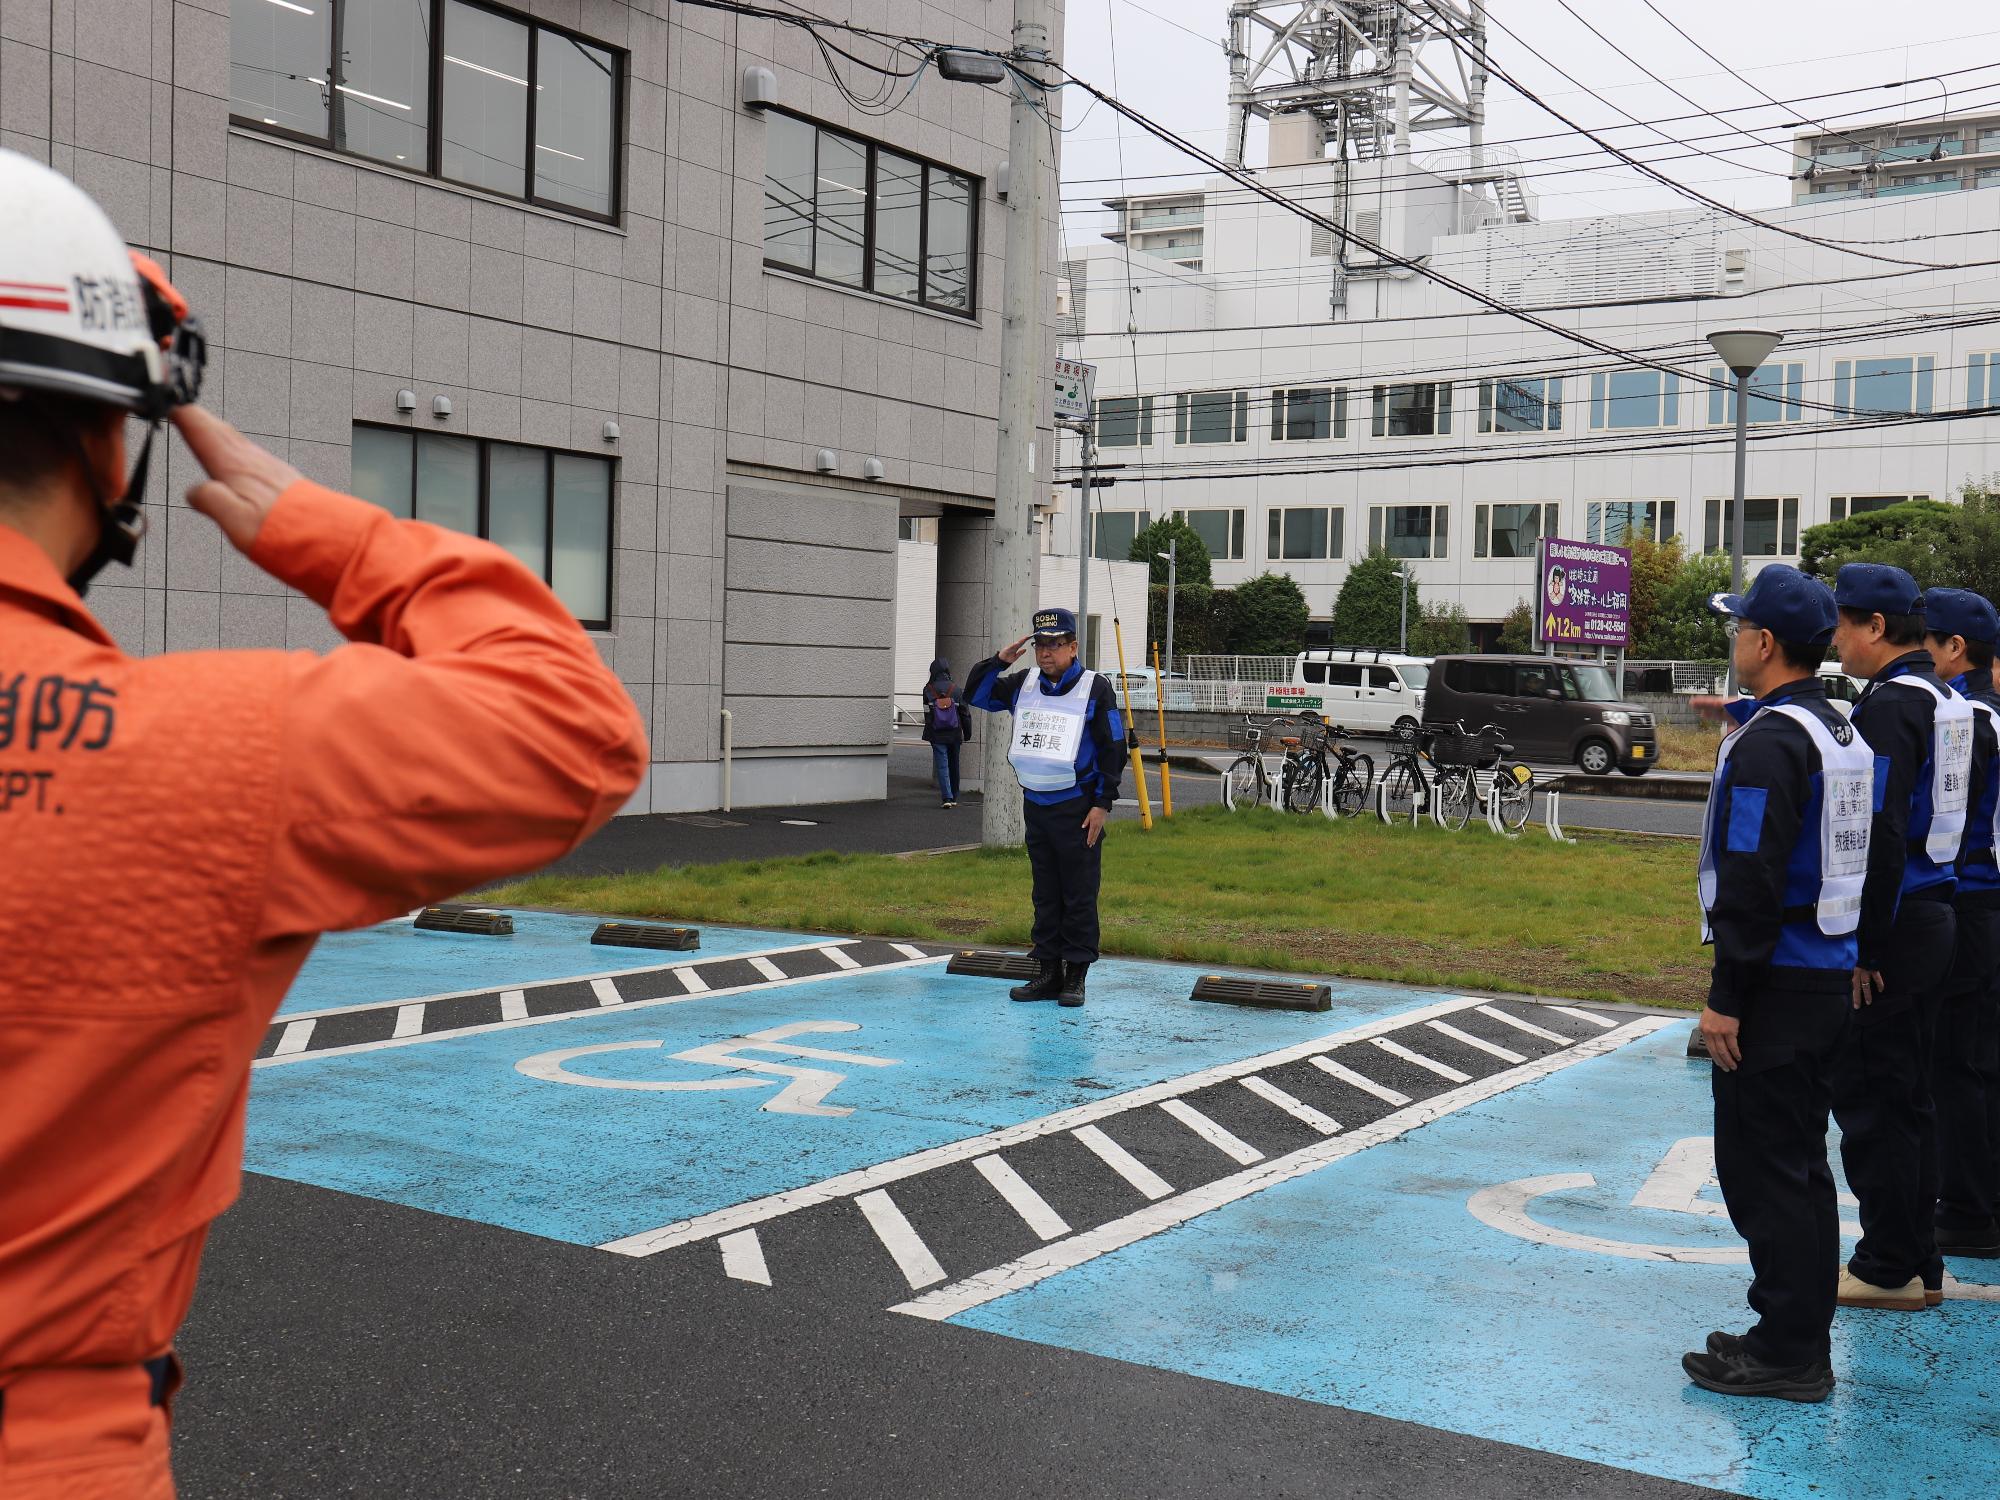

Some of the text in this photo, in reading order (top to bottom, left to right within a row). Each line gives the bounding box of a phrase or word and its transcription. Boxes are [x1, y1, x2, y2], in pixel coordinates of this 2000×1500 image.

[1035, 613, 1058, 623] BOSAI
[1269, 687, 1305, 696] 月極駐車場
[1019, 731, 1063, 752] 本部長
[0, 771, 65, 816] PT.
